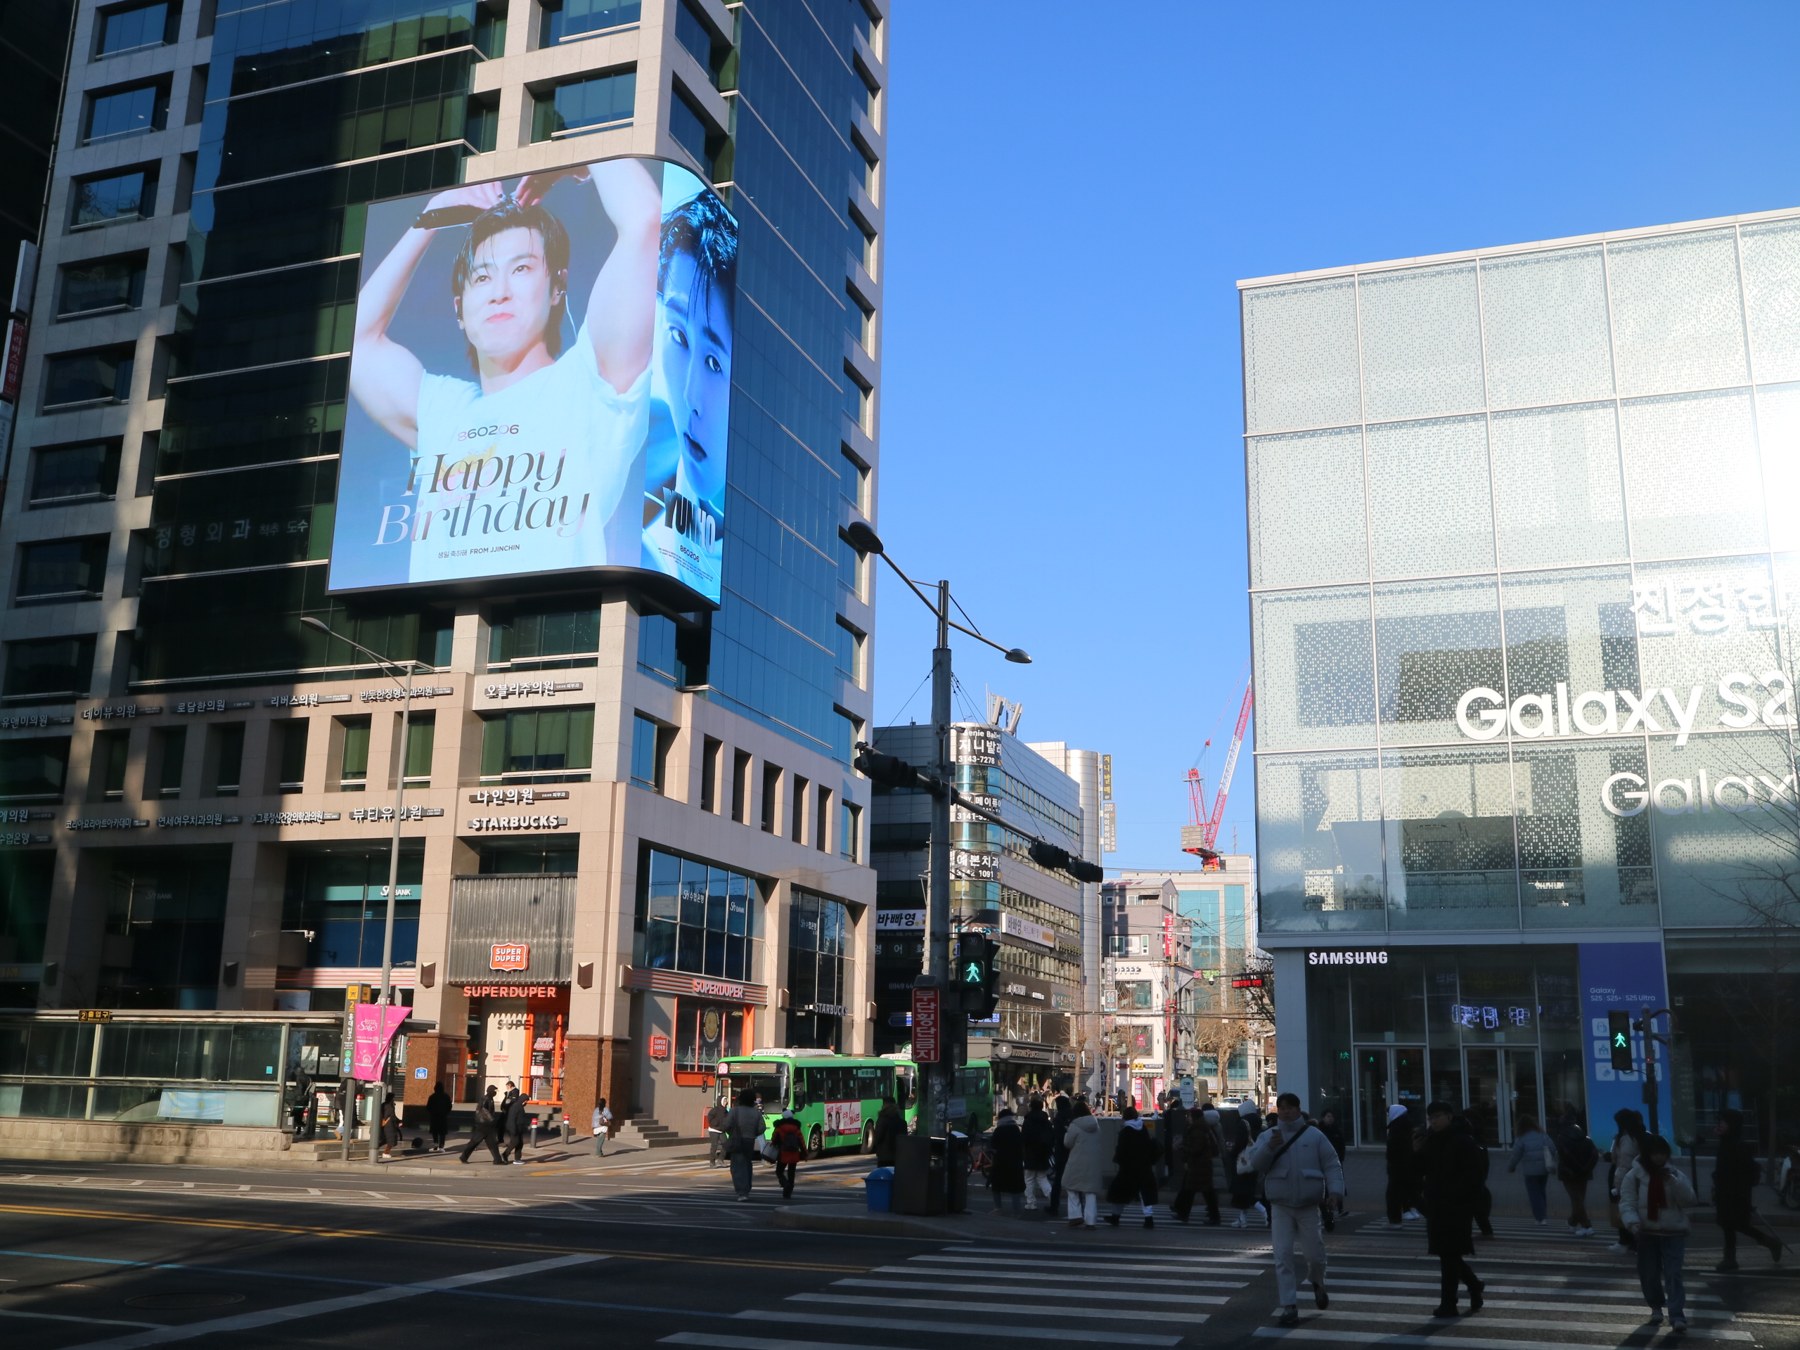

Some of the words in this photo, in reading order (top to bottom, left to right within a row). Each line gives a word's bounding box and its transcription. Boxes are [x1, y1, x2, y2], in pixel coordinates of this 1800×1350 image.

[457, 424, 520, 441] 860206
[400, 448, 566, 497] Happy
[372, 486, 590, 546] Birthday
[662, 486, 716, 554] YUNHO
[469, 547, 489, 555] FROM
[489, 545, 520, 555] JJINCHIN
[486, 680, 554, 697] 오블리주의원
[177, 699, 226, 713] 로담한의원
[271, 692, 319, 707] 리버스의원
[83, 706, 114, 720] 데이뷰
[117, 704, 137, 718] 의원
[1456, 682, 1703, 746] Galaxy
[477, 787, 533, 804] 나인의원
[158, 813, 222, 827] 연세여우치과의원
[256, 809, 323, 825] 그루정신건강의학과의원
[472, 815, 558, 829] STARBUCKS
[978, 869, 994, 878] 1091
[877, 912, 916, 927] 바빠영
[495, 955, 521, 963] DUPER
[1308, 951, 1389, 965] SAMSUNG
[463, 986, 556, 998] SUPERDUPER
[693, 979, 744, 998] SUPERDUPER
[1589, 987, 1616, 995] Galaxy
[814, 1002, 849, 1016] STARBUCKS
[915, 990, 936, 1060] 무단횡단금지
